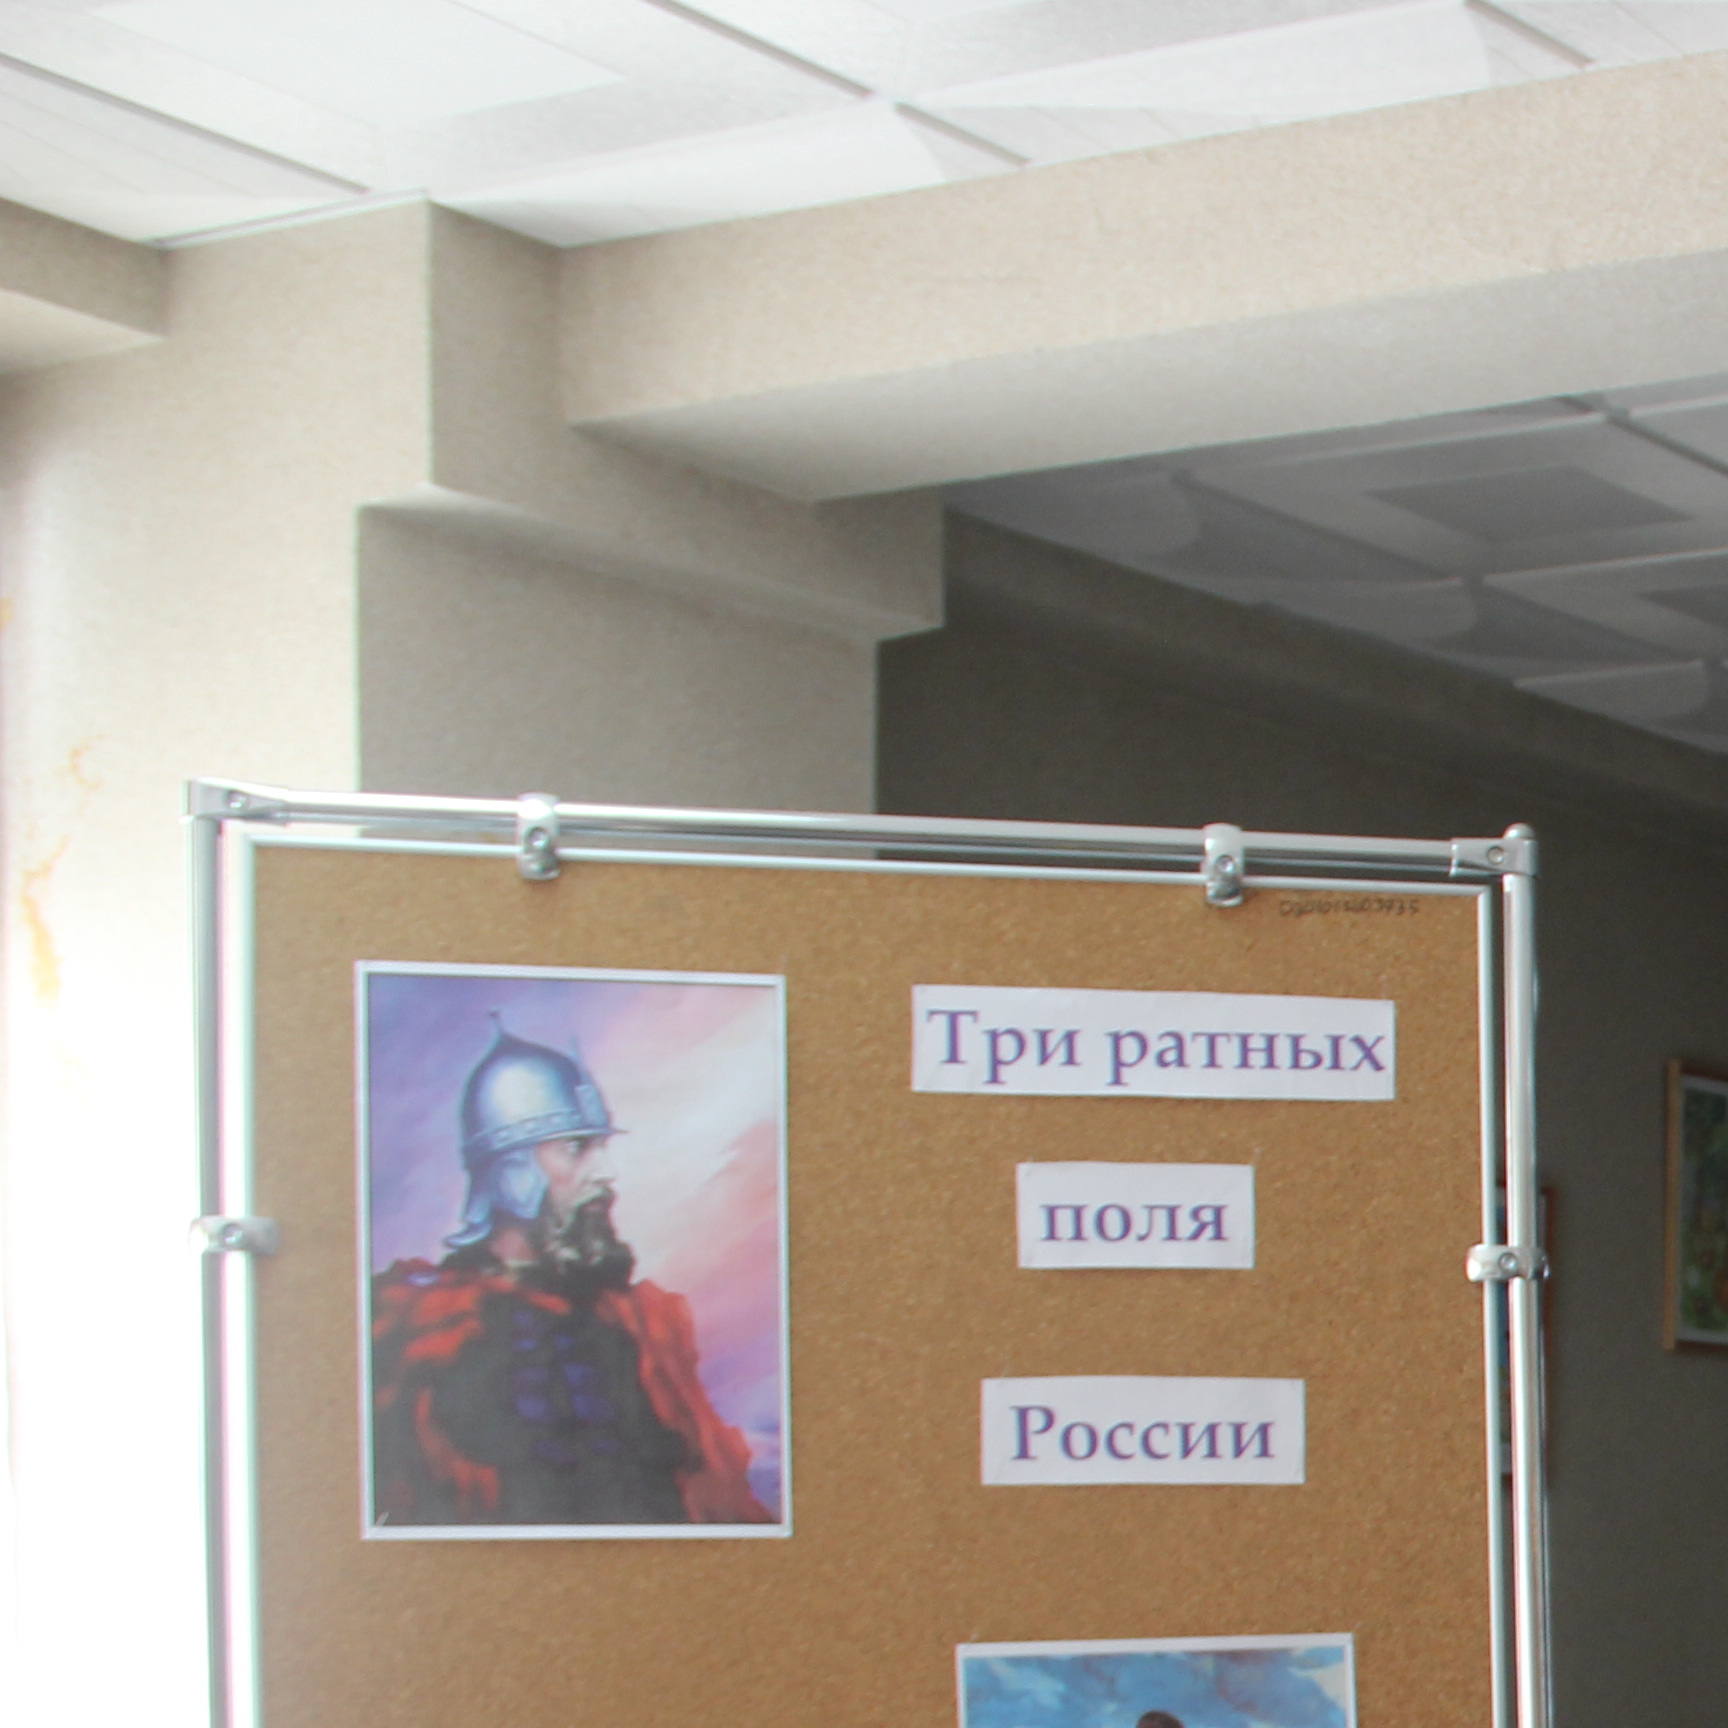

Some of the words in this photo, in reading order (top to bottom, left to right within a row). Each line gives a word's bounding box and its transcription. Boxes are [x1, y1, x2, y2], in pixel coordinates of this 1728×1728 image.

[927, 1009, 1082, 1084] Три
[1106, 1028, 1386, 1086] ратных
[1040, 1202, 1229, 1243] поля
[1009, 1404, 1276, 1461] России
